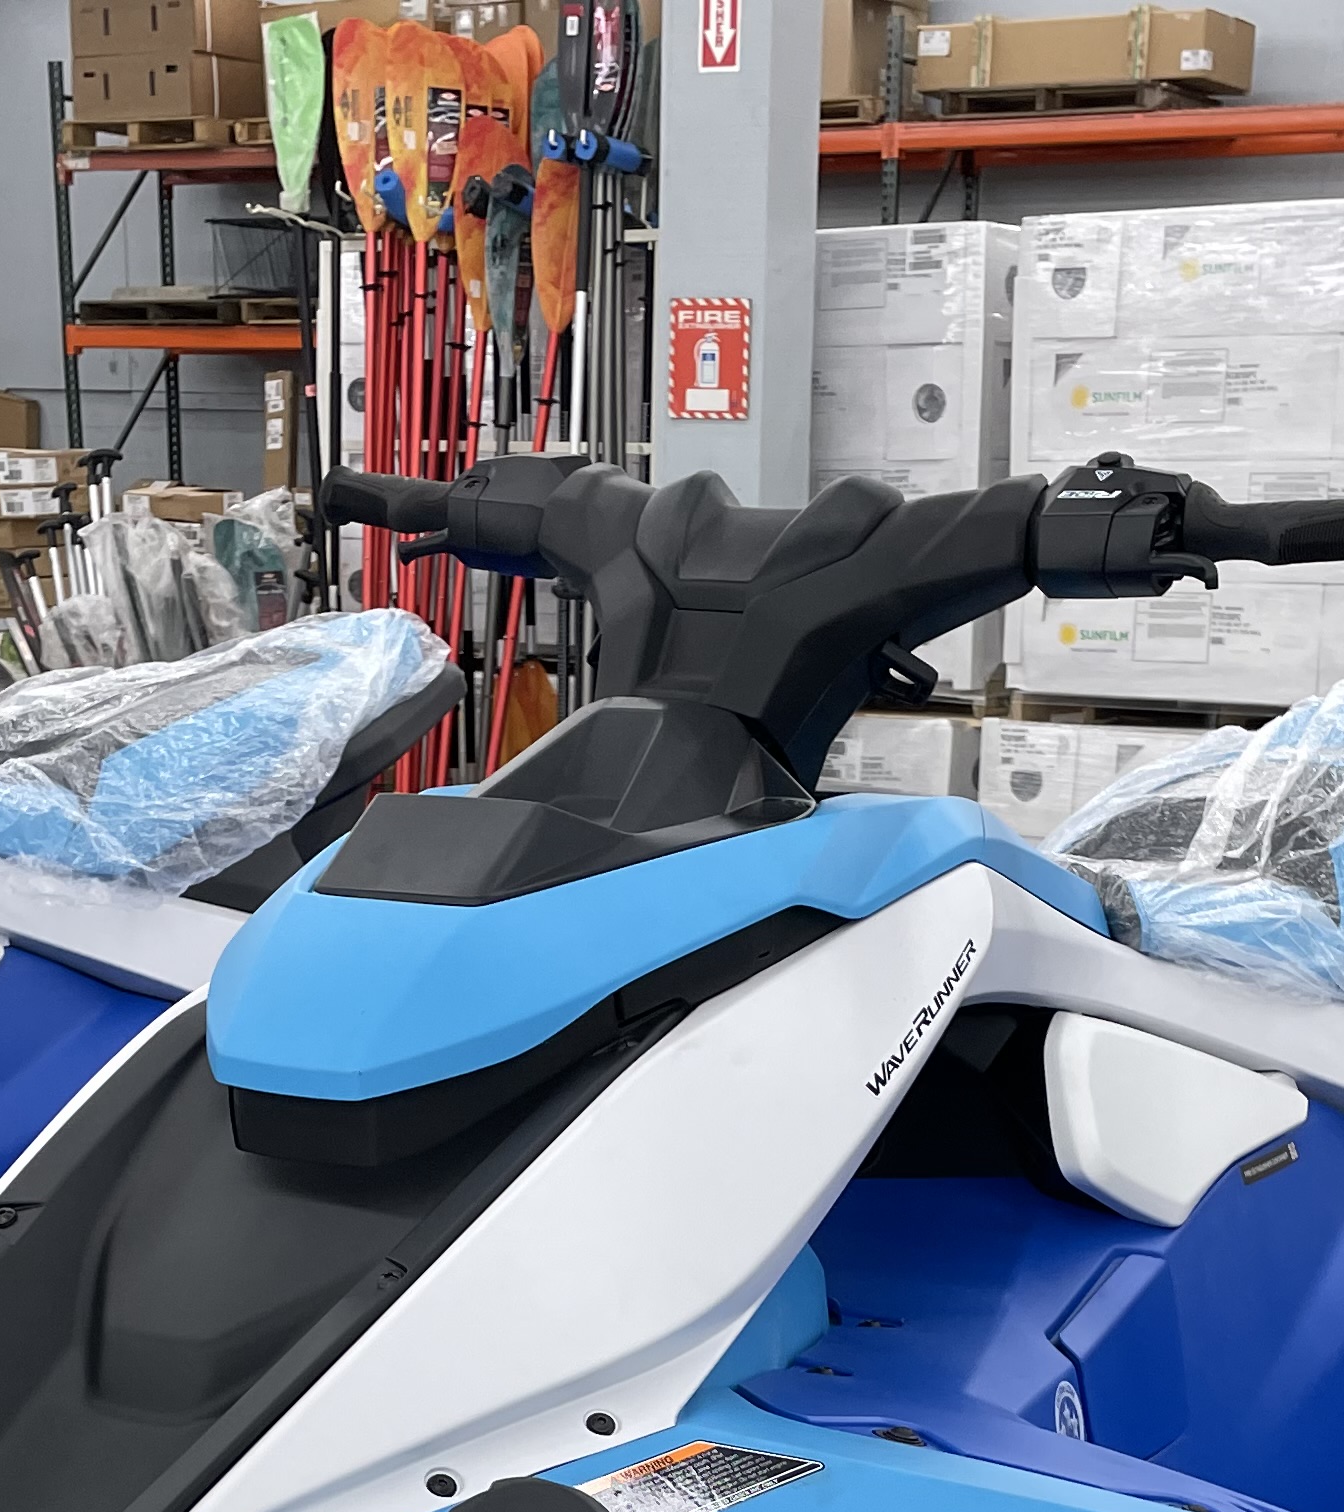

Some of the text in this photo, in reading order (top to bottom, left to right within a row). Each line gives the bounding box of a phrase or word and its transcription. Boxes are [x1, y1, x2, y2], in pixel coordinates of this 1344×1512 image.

[678, 310, 741, 323] FIRE
[1092, 391, 1142, 404] SUNFILM
[1080, 629, 1129, 641] SUNFILM
[620, 1455, 675, 1481] WARNING
